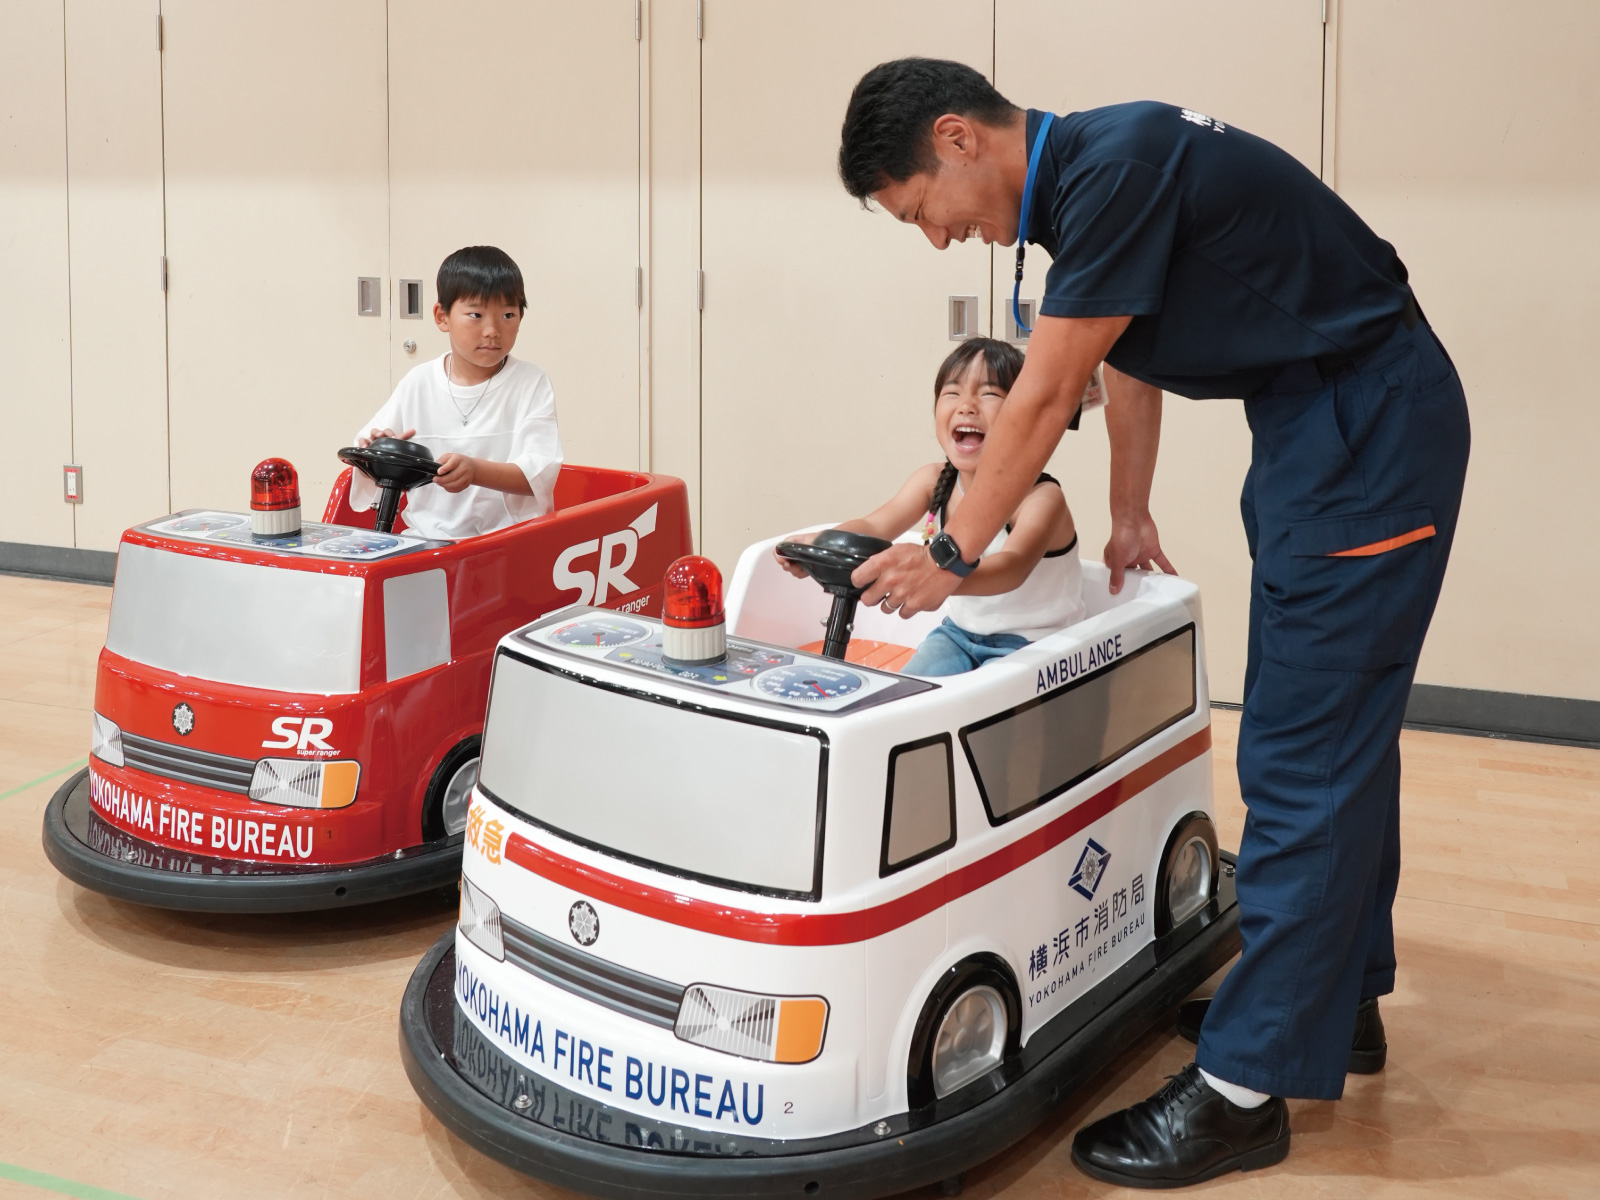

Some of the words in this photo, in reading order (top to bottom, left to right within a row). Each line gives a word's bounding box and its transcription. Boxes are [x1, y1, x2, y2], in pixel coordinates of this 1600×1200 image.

[552, 529, 641, 607] SR
[1036, 633, 1123, 694] AMBULANCE
[261, 716, 334, 750] SR
[297, 749, 316, 757] super
[316, 749, 341, 757] ranger
[89, 766, 154, 832] YOKOHAMA
[159, 804, 203, 845] FIRE
[211, 816, 314, 859] BUREAU
[466, 804, 505, 866] 救急
[1028, 873, 1145, 981] 横浜市消防局
[1029, 962, 1085, 1008] YOKOHAMA
[1088, 941, 1108, 967] FIRE
[1111, 912, 1145, 948] BUREAU
[457, 955, 545, 1063] YOKOHAMA
[553, 1029, 613, 1093] FIRE
[625, 1059, 765, 1126] BUREAU
[784, 1101, 795, 1115] 2
